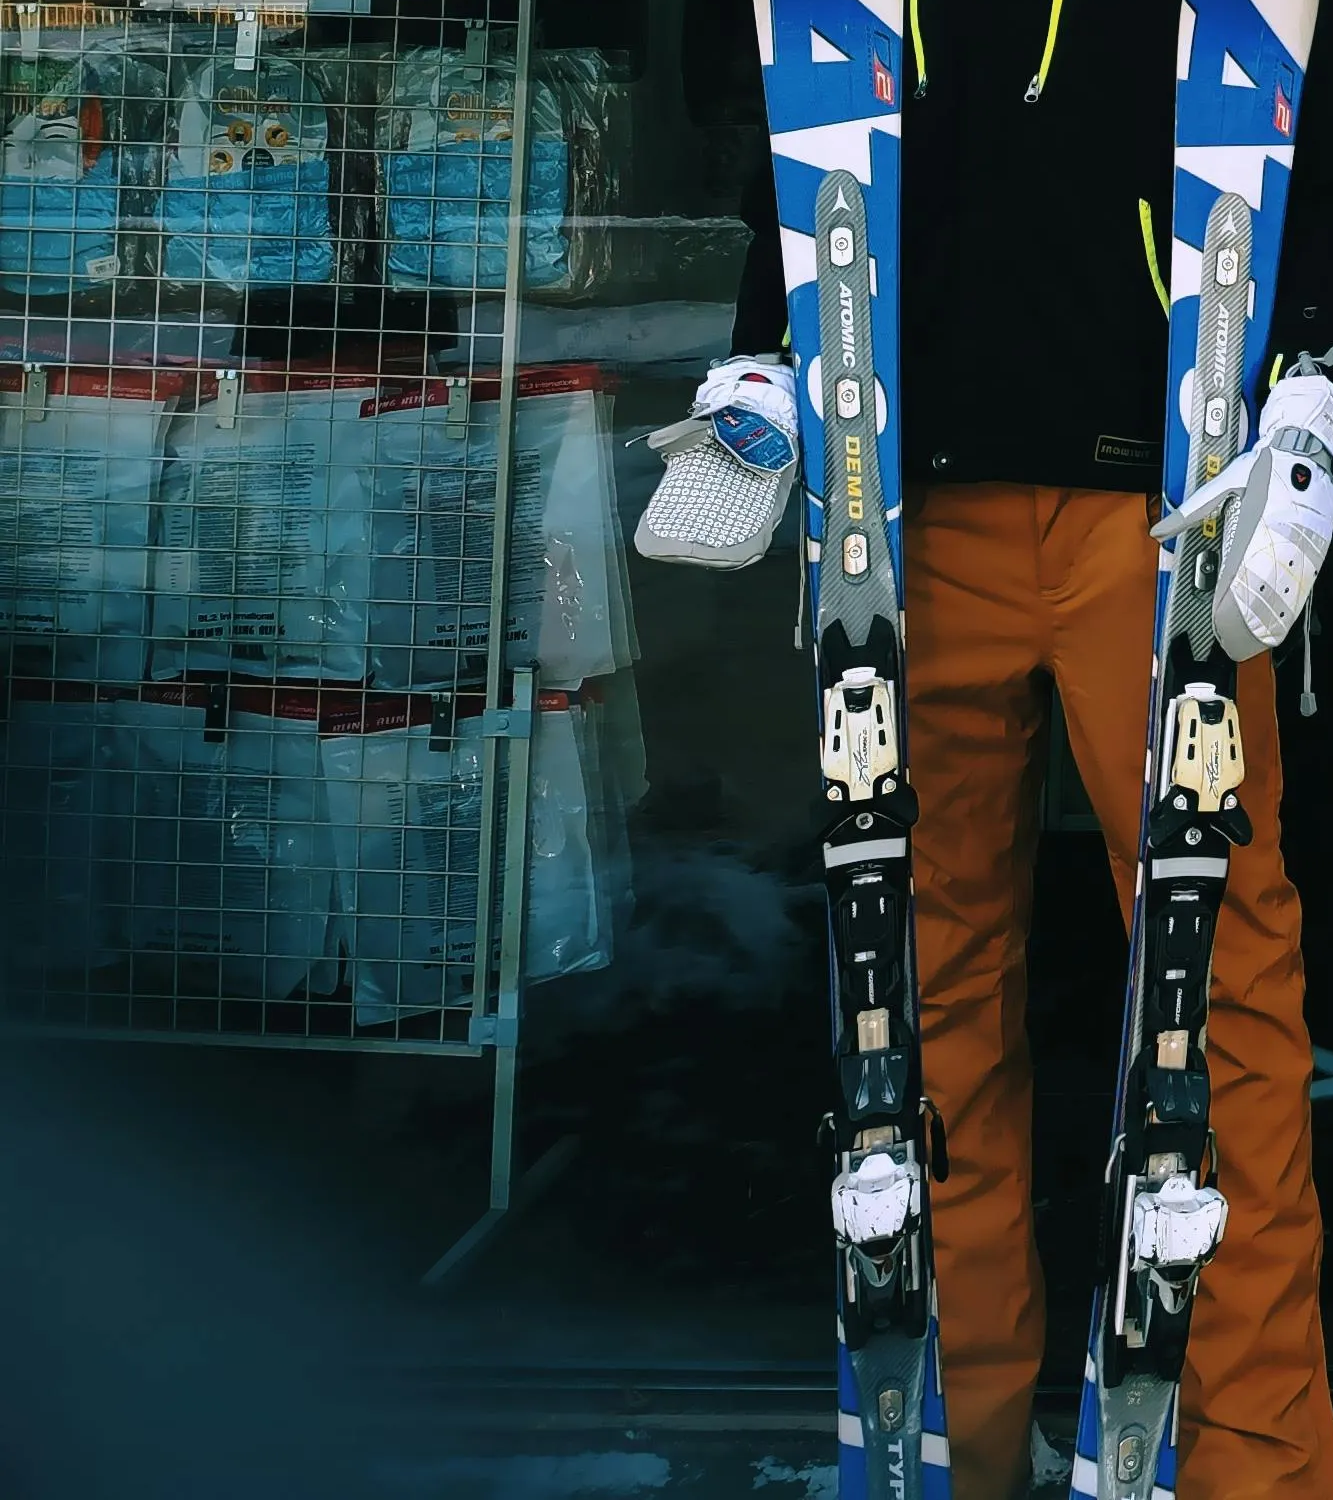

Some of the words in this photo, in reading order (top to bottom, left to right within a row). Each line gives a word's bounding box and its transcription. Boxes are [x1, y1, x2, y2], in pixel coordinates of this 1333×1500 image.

[837, 281, 857, 370] ATOMIC
[1211, 302, 1229, 389] ATOMIC
[844, 435, 866, 520] DEMO
